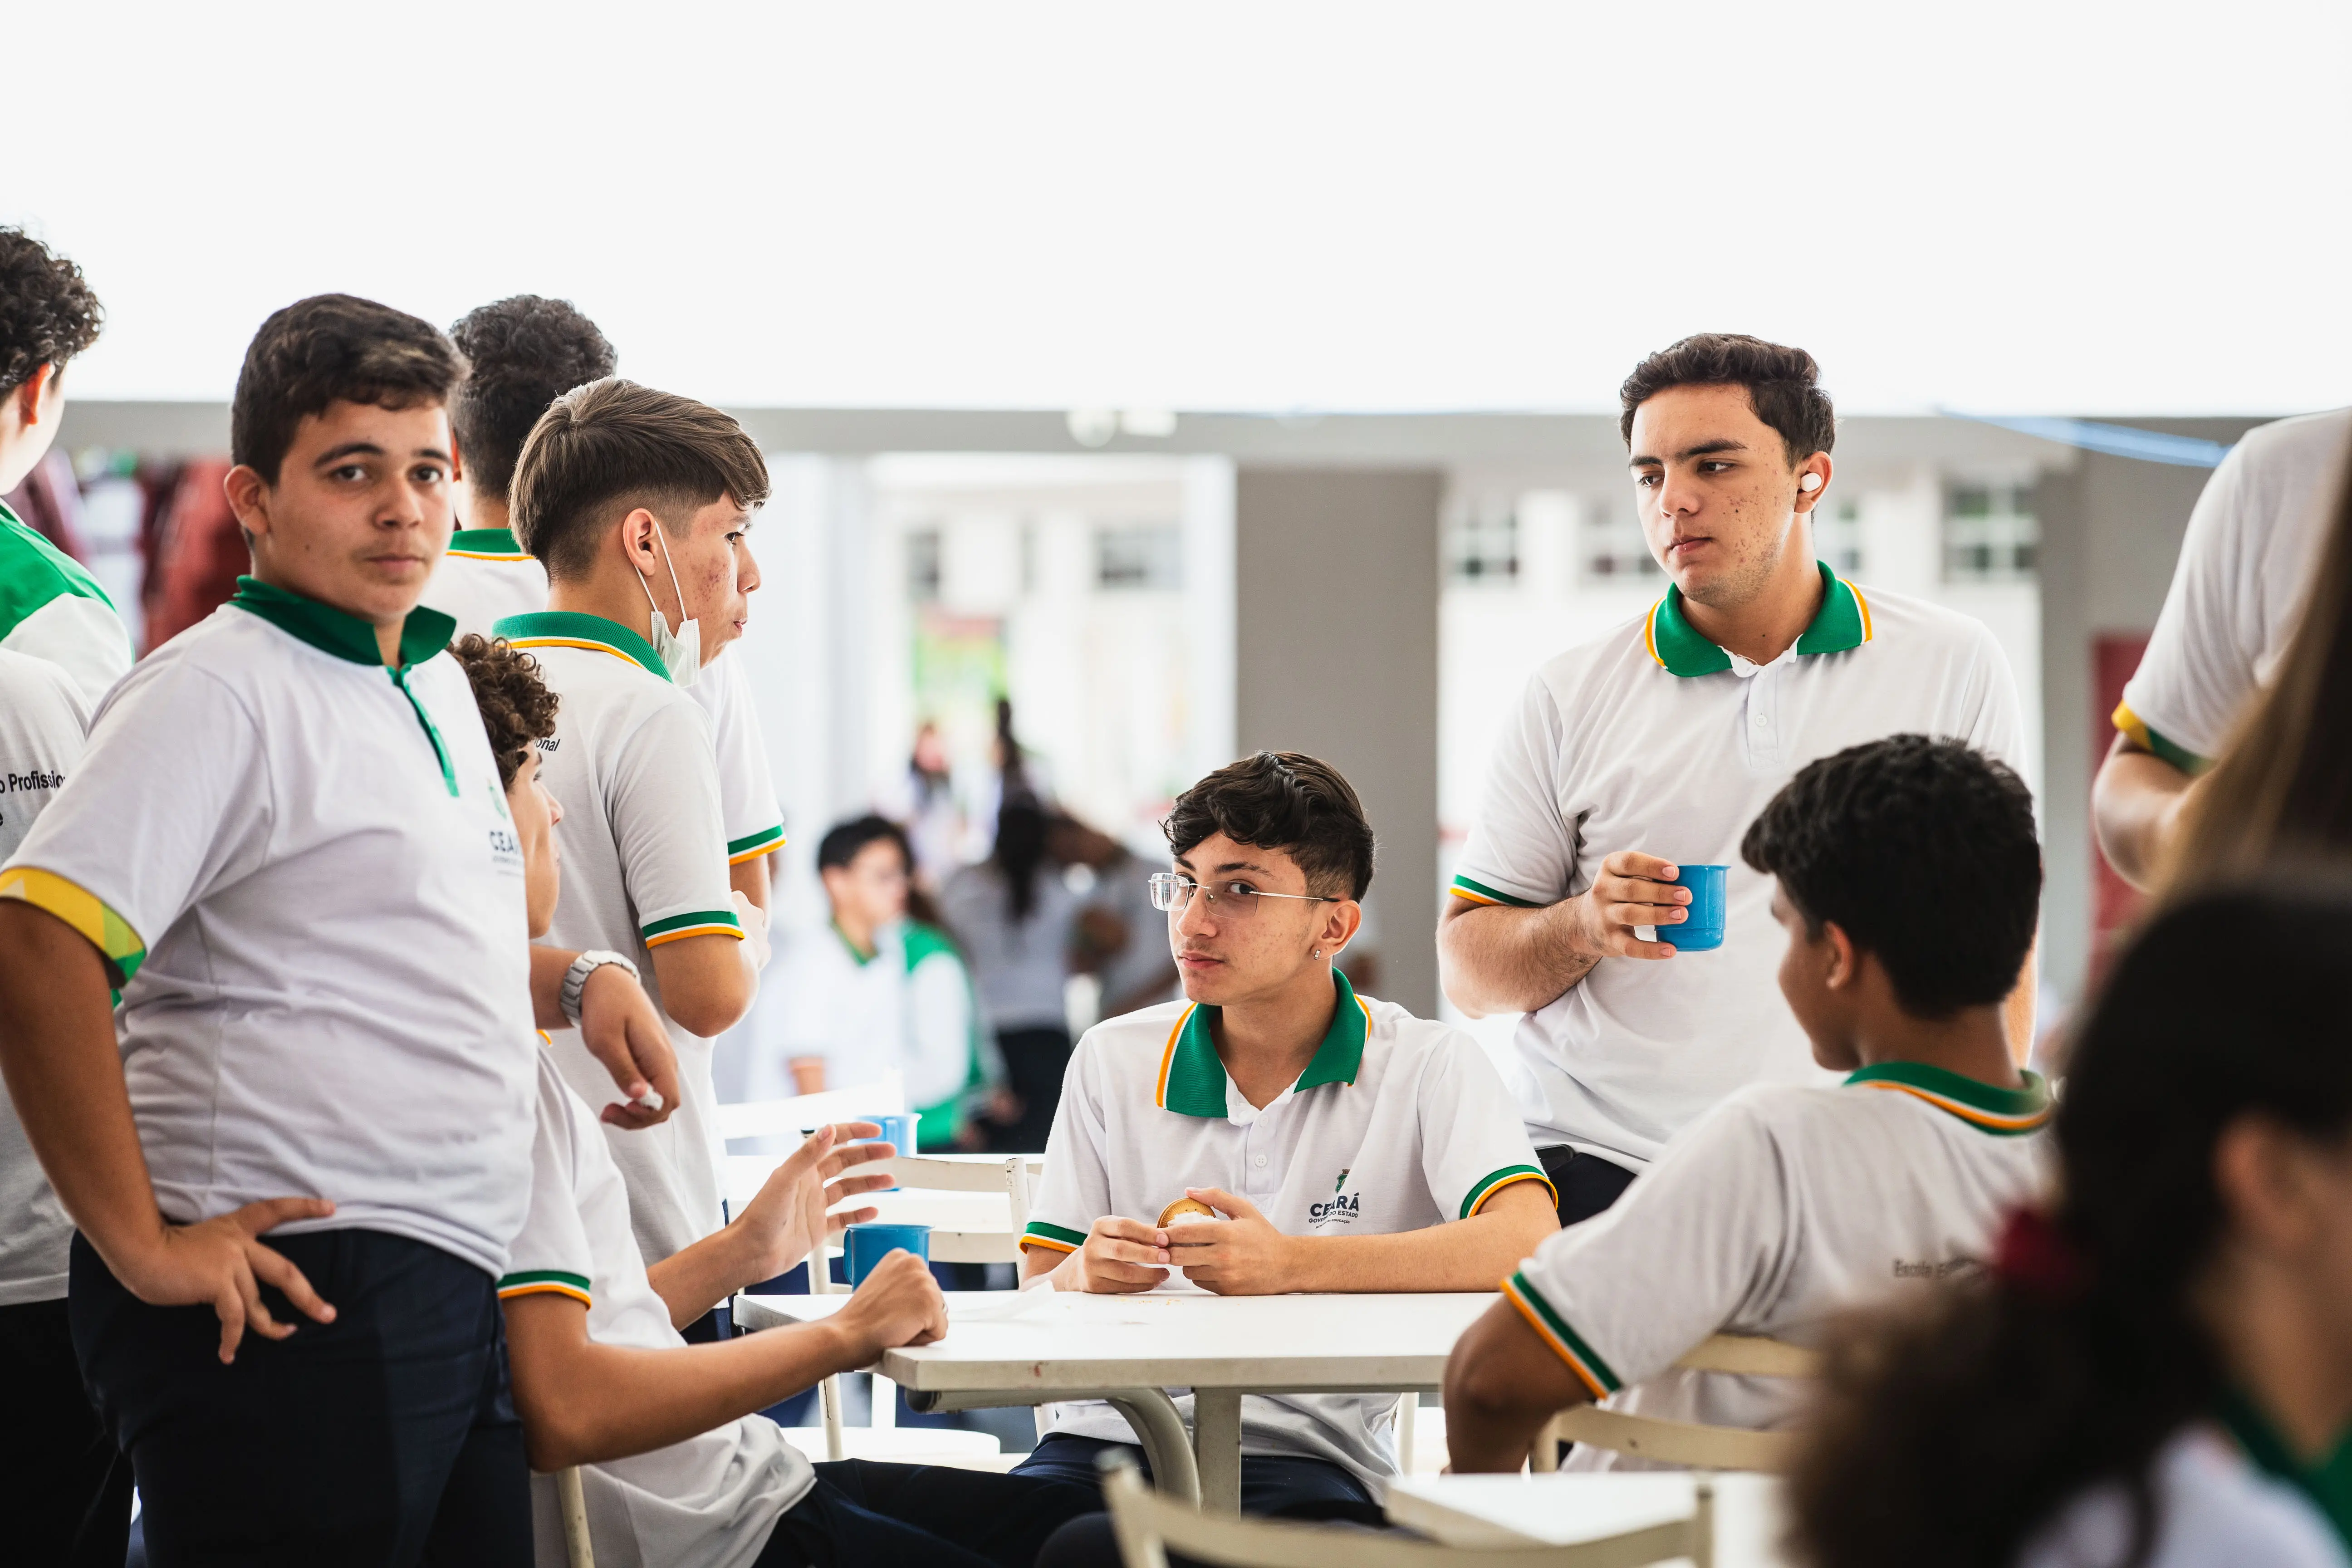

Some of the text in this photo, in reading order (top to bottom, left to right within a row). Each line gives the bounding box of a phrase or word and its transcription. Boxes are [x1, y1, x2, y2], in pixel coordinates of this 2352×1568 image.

[8, 770, 66, 792] Profissio
[1310, 1192, 1359, 1217] CEARÁ
[1338, 1210, 1358, 1218] ESTADO
